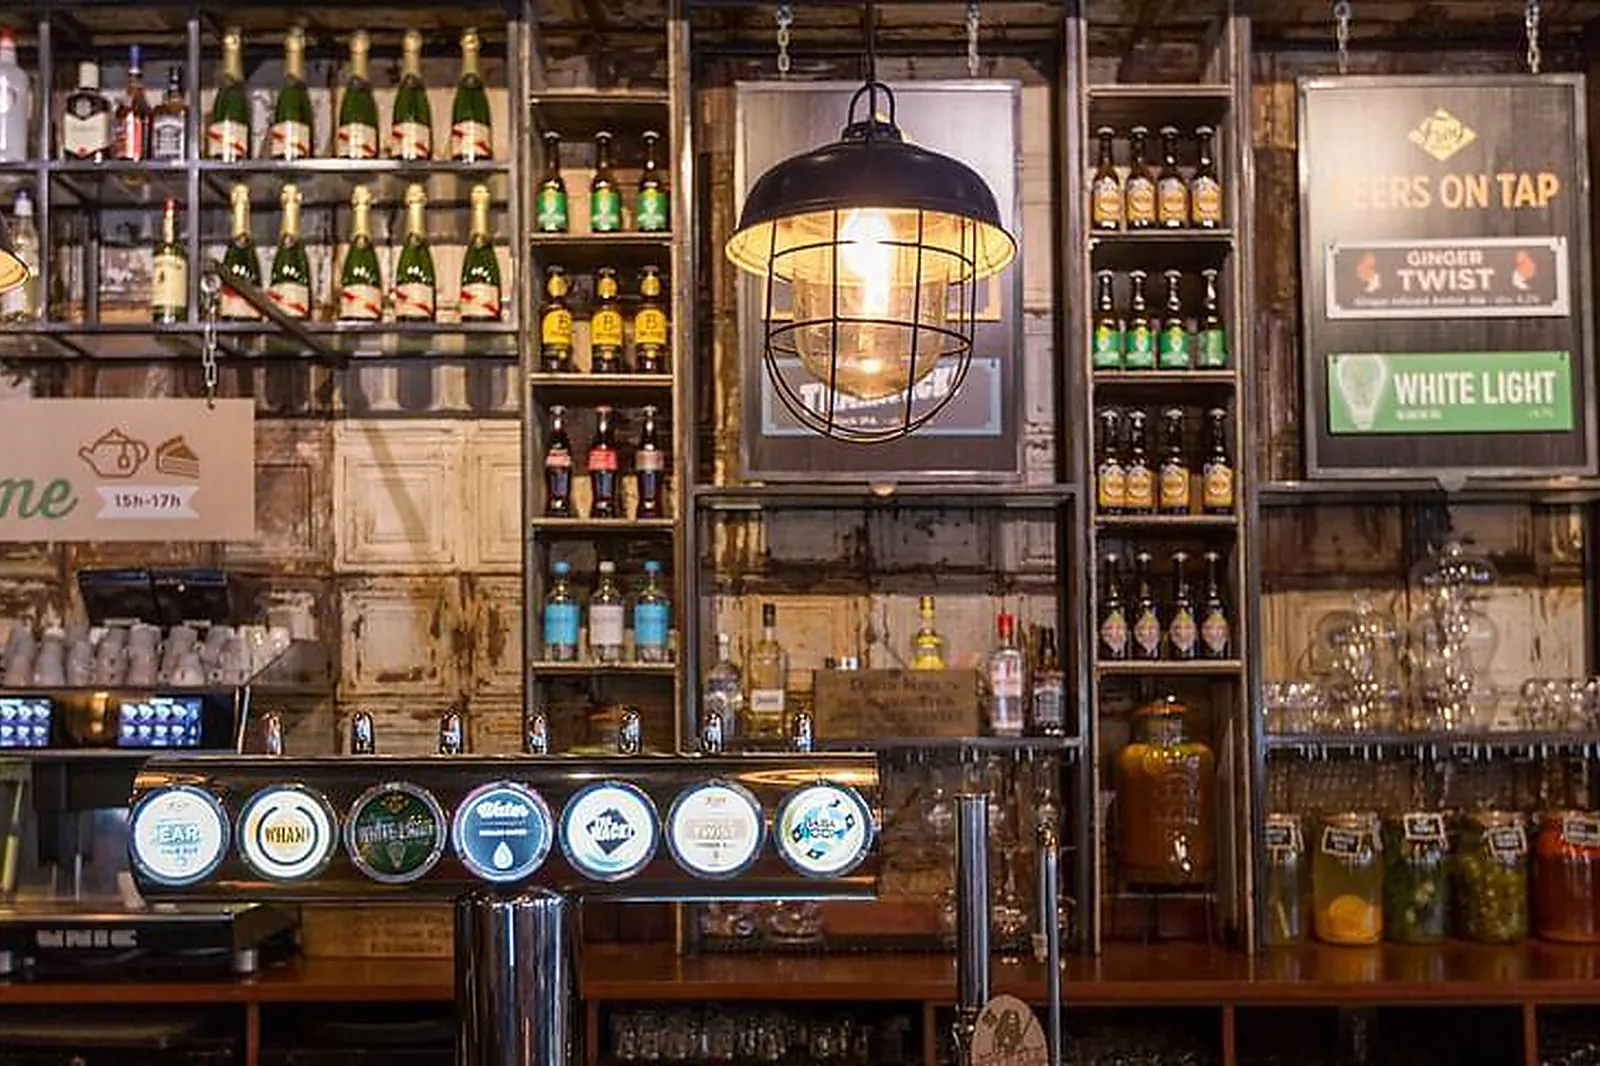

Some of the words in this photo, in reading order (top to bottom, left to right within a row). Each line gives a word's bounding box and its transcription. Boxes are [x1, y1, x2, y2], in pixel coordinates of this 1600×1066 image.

[1439, 173, 1489, 208] ON
[1497, 172, 1560, 208] TAP
[1407, 250, 1484, 265] GINGER
[1397, 268, 1495, 291] TWIST
[1393, 372, 1475, 405] WHITE
[1482, 371, 1557, 404] LIGHT
